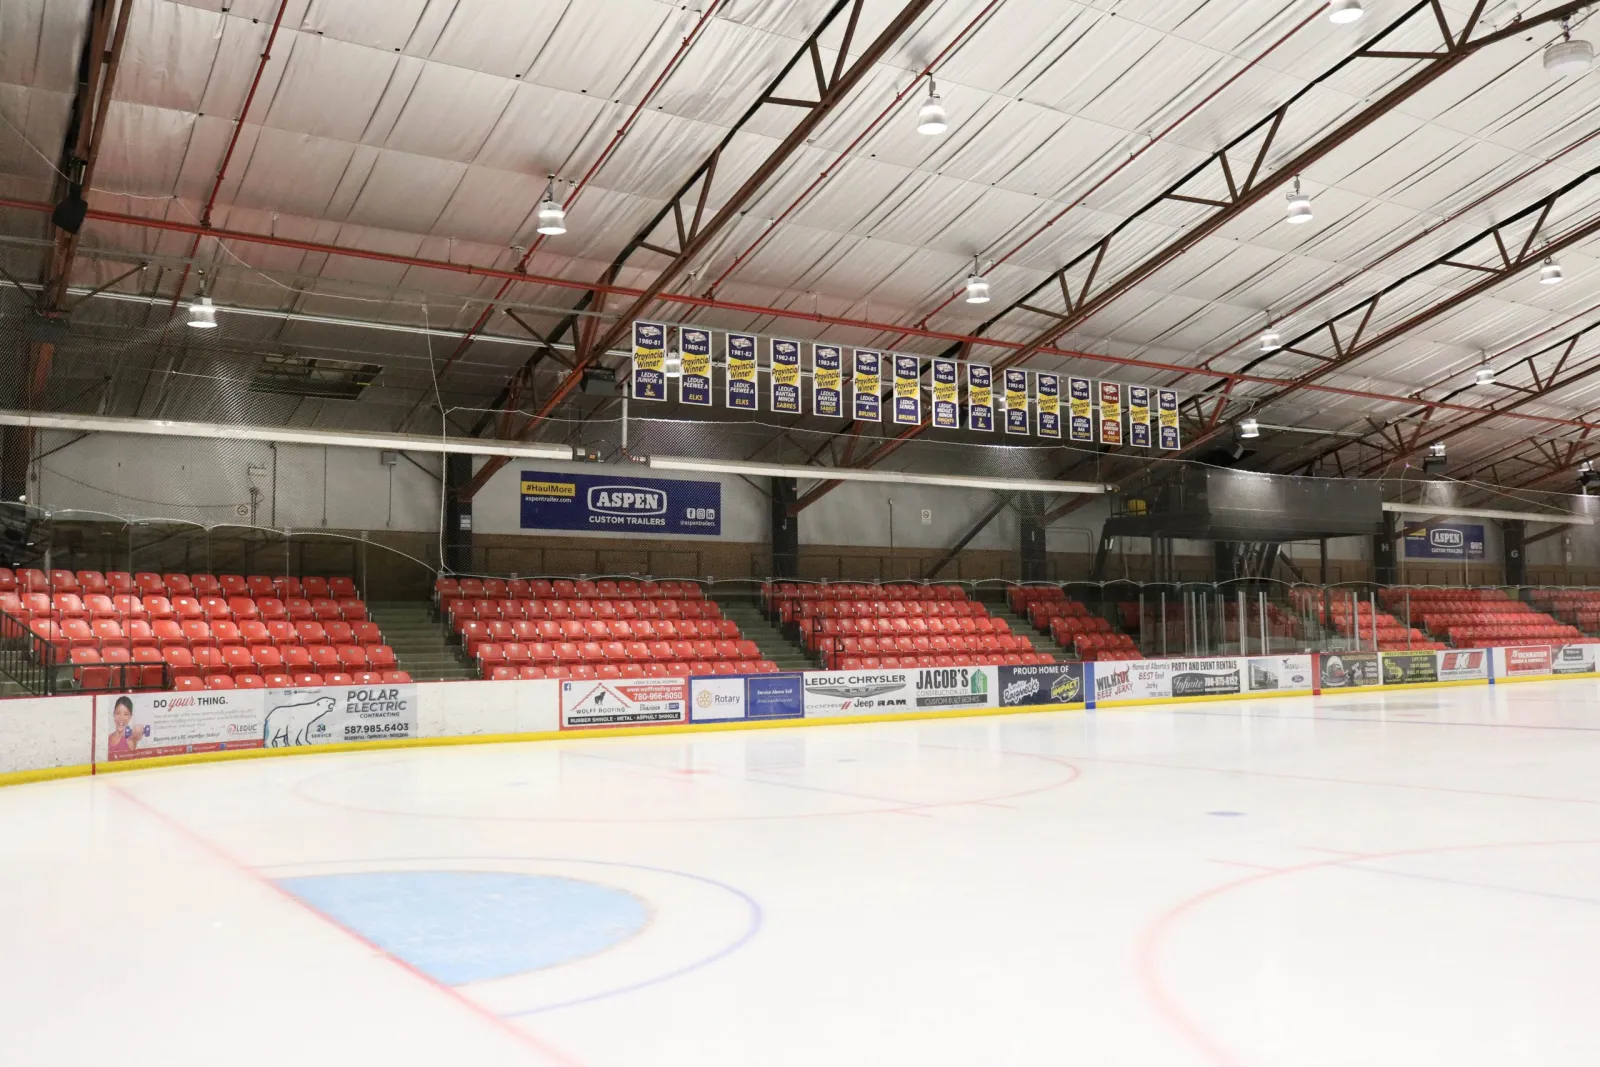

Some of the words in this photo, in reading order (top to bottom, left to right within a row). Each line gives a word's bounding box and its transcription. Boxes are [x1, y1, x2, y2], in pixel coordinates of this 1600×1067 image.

[639, 338, 660, 346] 1980-81
[634, 350, 665, 361] Provincial
[681, 355, 710, 366] Provincial
[637, 360, 660, 368] Winner
[728, 360, 756, 372] Provincial
[684, 365, 705, 374] Winner
[772, 365, 799, 376] Provincial
[775, 375, 795, 383] Winner
[815, 371, 840, 381] Provincial
[527, 484, 573, 494] #HaulMore
[597, 492, 658, 509] ASPEN
[589, 516, 624, 524] CUSTOM
[627, 517, 665, 525] TRAILERS
[1434, 533, 1459, 543] ASPEN
[1382, 543, 1389, 552] H
[1013, 667, 1037, 675] PROUD
[1039, 666, 1059, 674] HOME
[1172, 662, 1188, 671] PARTY
[1189, 662, 1199, 671] AND
[1200, 661, 1215, 670] EVENT
[1216, 661, 1237, 669] RENTALS
[805, 677, 844, 686] LEDUC
[848, 675, 906, 684] CHRYSLER
[916, 669, 968, 689] JACOB'S
[1139, 672, 1153, 680] BEST
[1053, 680, 1078, 695] IMPACT
[1097, 688, 1112, 699] BEEF
[1115, 683, 1133, 695] JERKY
[347, 689, 399, 702] POLAR
[715, 695, 740, 703] Rotary
[153, 700, 167, 708] DO
[168, 696, 196, 711] your
[198, 697, 228, 706] THING.
[346, 701, 407, 713] ELECTRIC
[854, 699, 874, 709] Jeep
[236, 724, 257, 732] LEDUC
[344, 723, 408, 734] 587.985.6403
